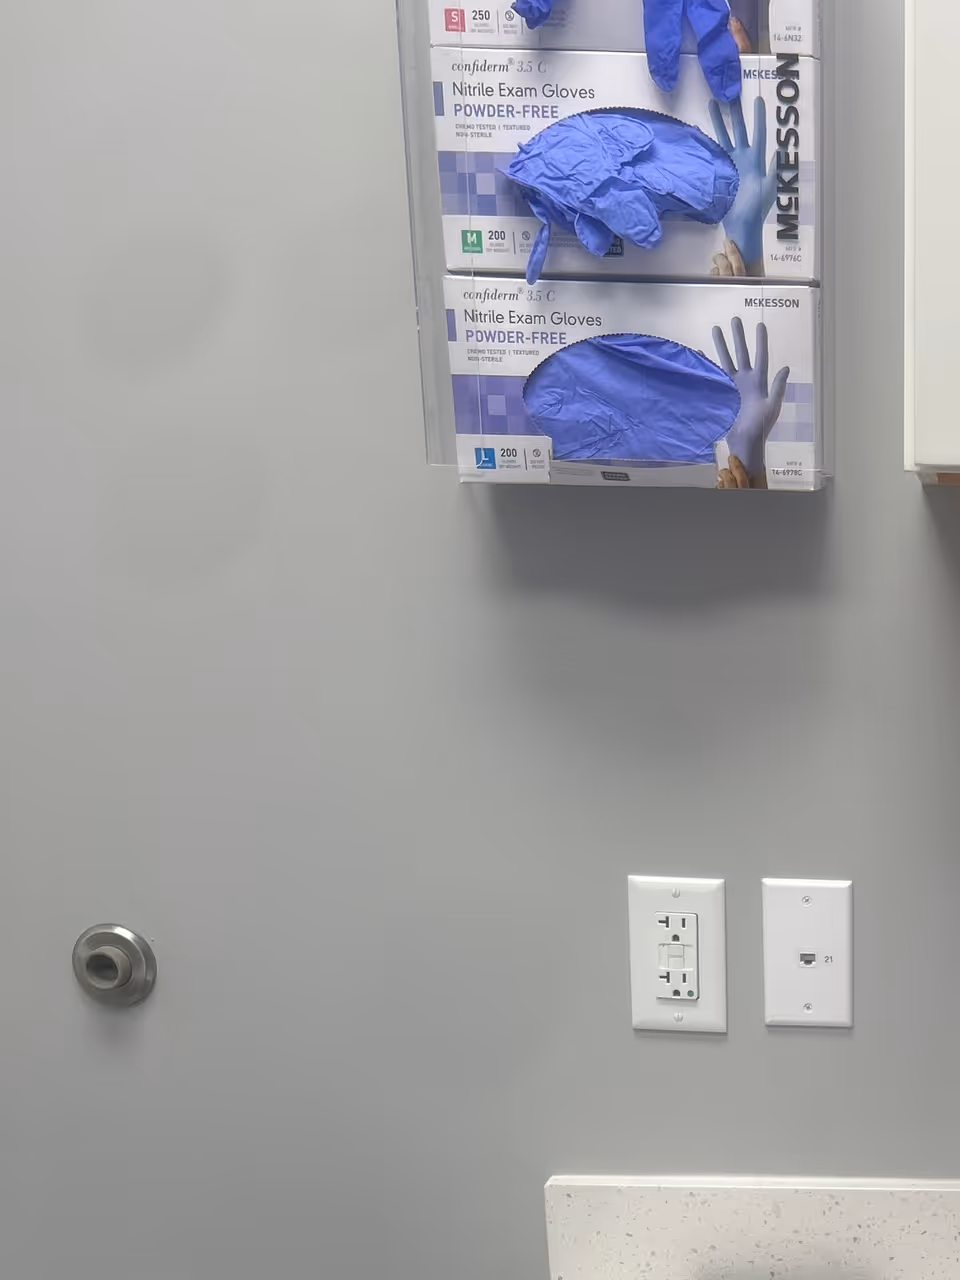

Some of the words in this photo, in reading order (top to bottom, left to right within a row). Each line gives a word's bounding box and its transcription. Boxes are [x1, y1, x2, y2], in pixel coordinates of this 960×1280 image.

[451, 11, 459, 22] S
[472, 10, 490, 20] 250
[516, 61, 533, 73] 3.5
[452, 81, 494, 97] Nitrile
[499, 82, 537, 98] Exam
[542, 83, 595, 99] Gloves
[454, 103, 559, 119] POWDER-FREE
[467, 232, 477, 244] M
[488, 231, 506, 240] 200
[526, 290, 542, 302] 3.5
[546, 290, 556, 302] C
[464, 309, 505, 324] Nitrile
[508, 310, 546, 325] Exam
[550, 311, 602, 327] Gloves
[465, 329, 567, 345] POWDER-FREE
[500, 448, 517, 457] 200
[824, 955, 833, 964] 21
